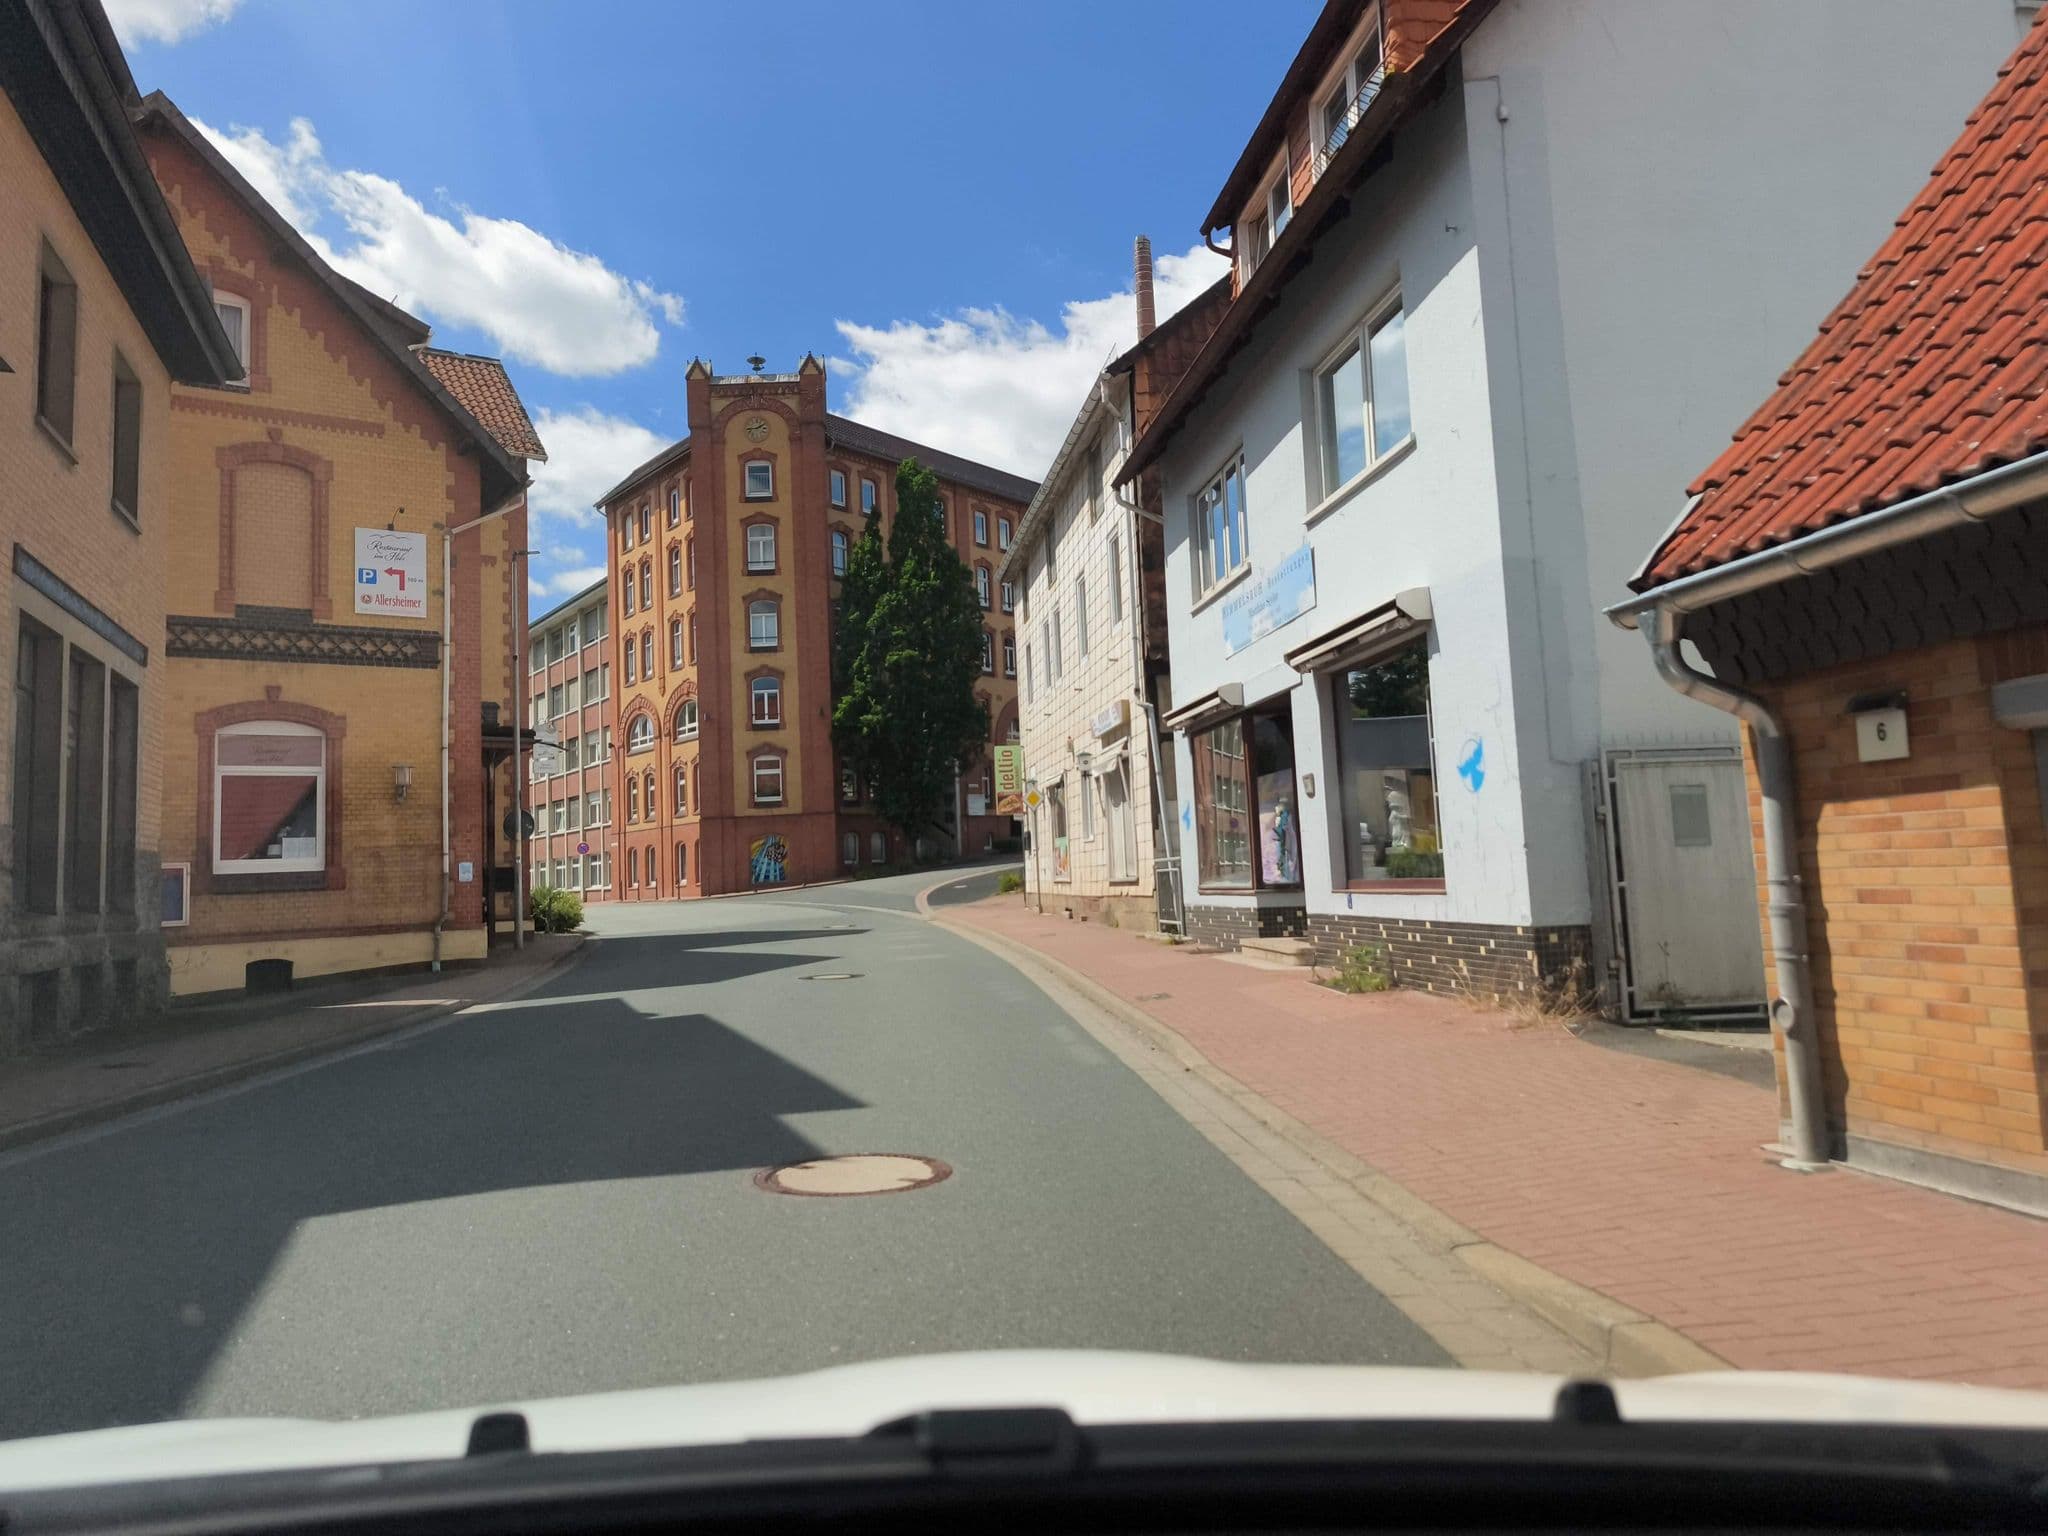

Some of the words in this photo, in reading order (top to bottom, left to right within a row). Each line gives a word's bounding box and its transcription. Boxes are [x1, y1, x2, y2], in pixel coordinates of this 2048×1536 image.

[367, 540, 412, 554] Restaurant
[362, 569, 374, 583] P
[375, 594, 421, 608] Allersheimer
[1876, 722, 1887, 742] 6
[998, 750, 1015, 790] dellio
